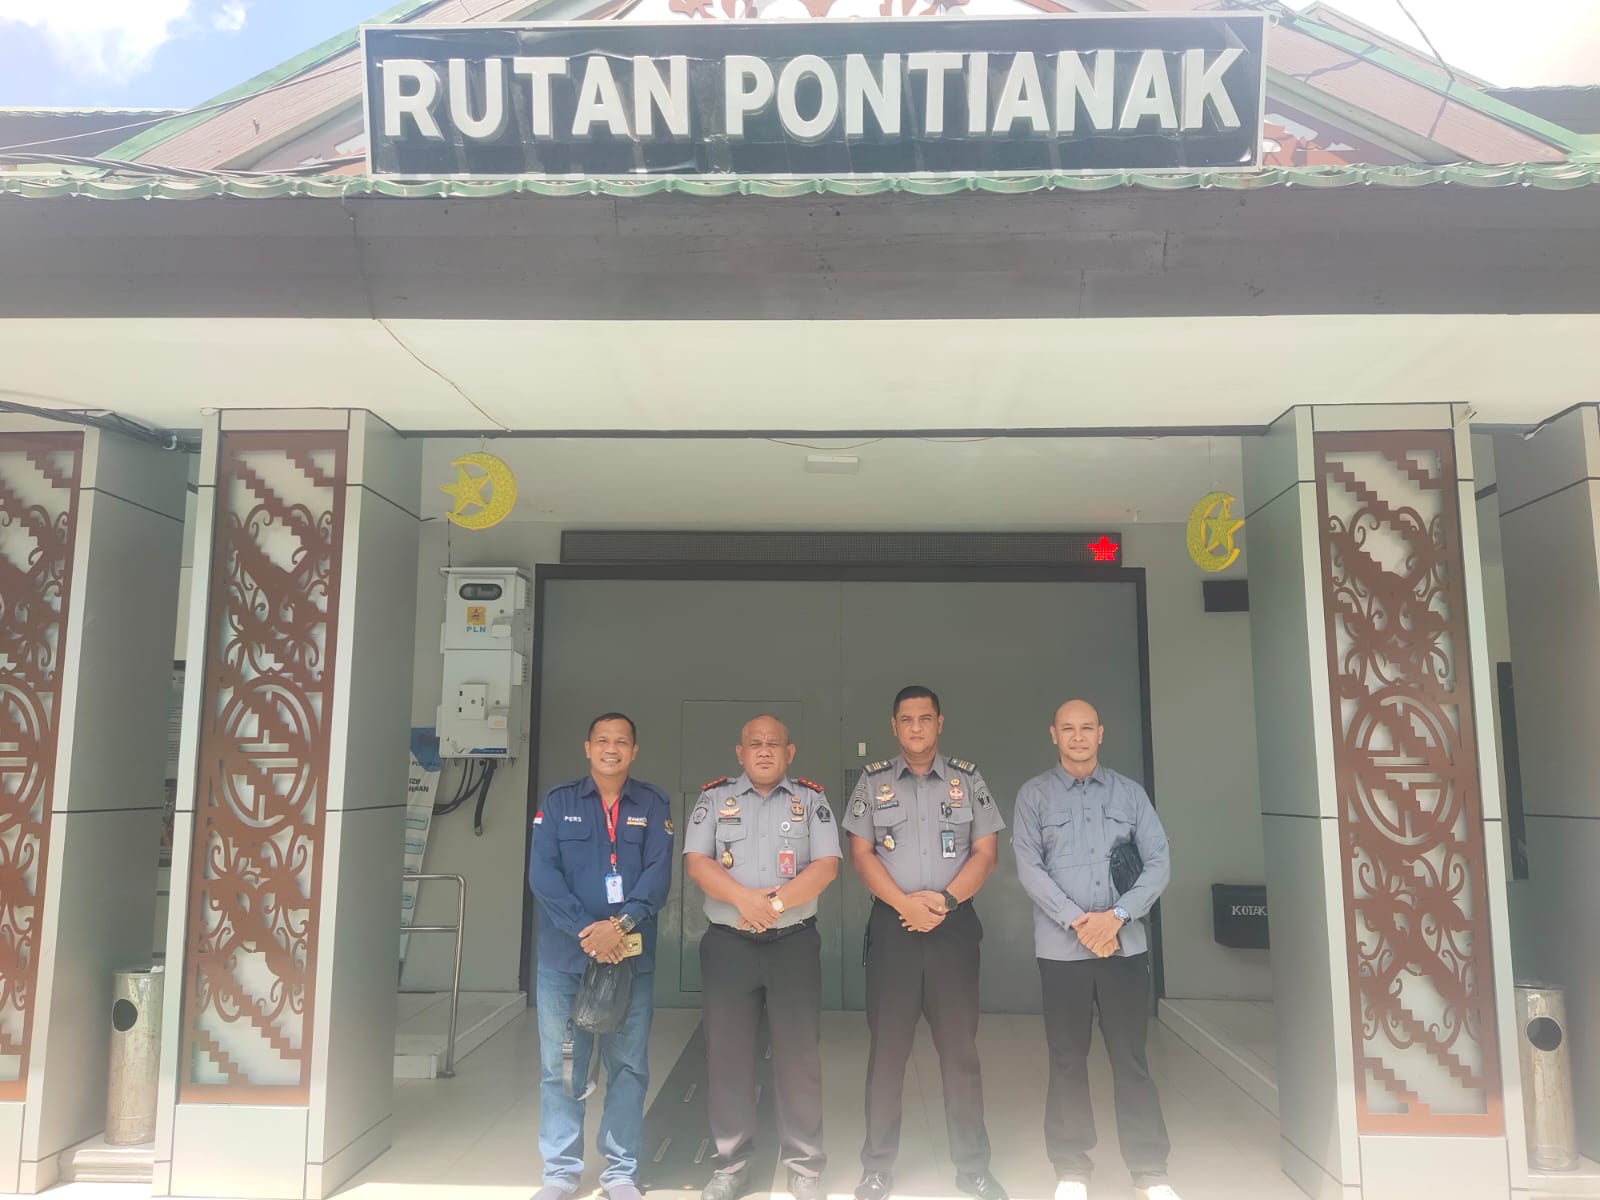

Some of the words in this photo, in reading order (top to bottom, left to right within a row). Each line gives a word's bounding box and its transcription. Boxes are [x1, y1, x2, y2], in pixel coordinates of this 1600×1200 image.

[382, 55, 689, 139] RUTAN
[724, 48, 1242, 138] PONTIANAK
[564, 815, 583, 823] PERS
[1231, 905, 1267, 916] KOTAK
